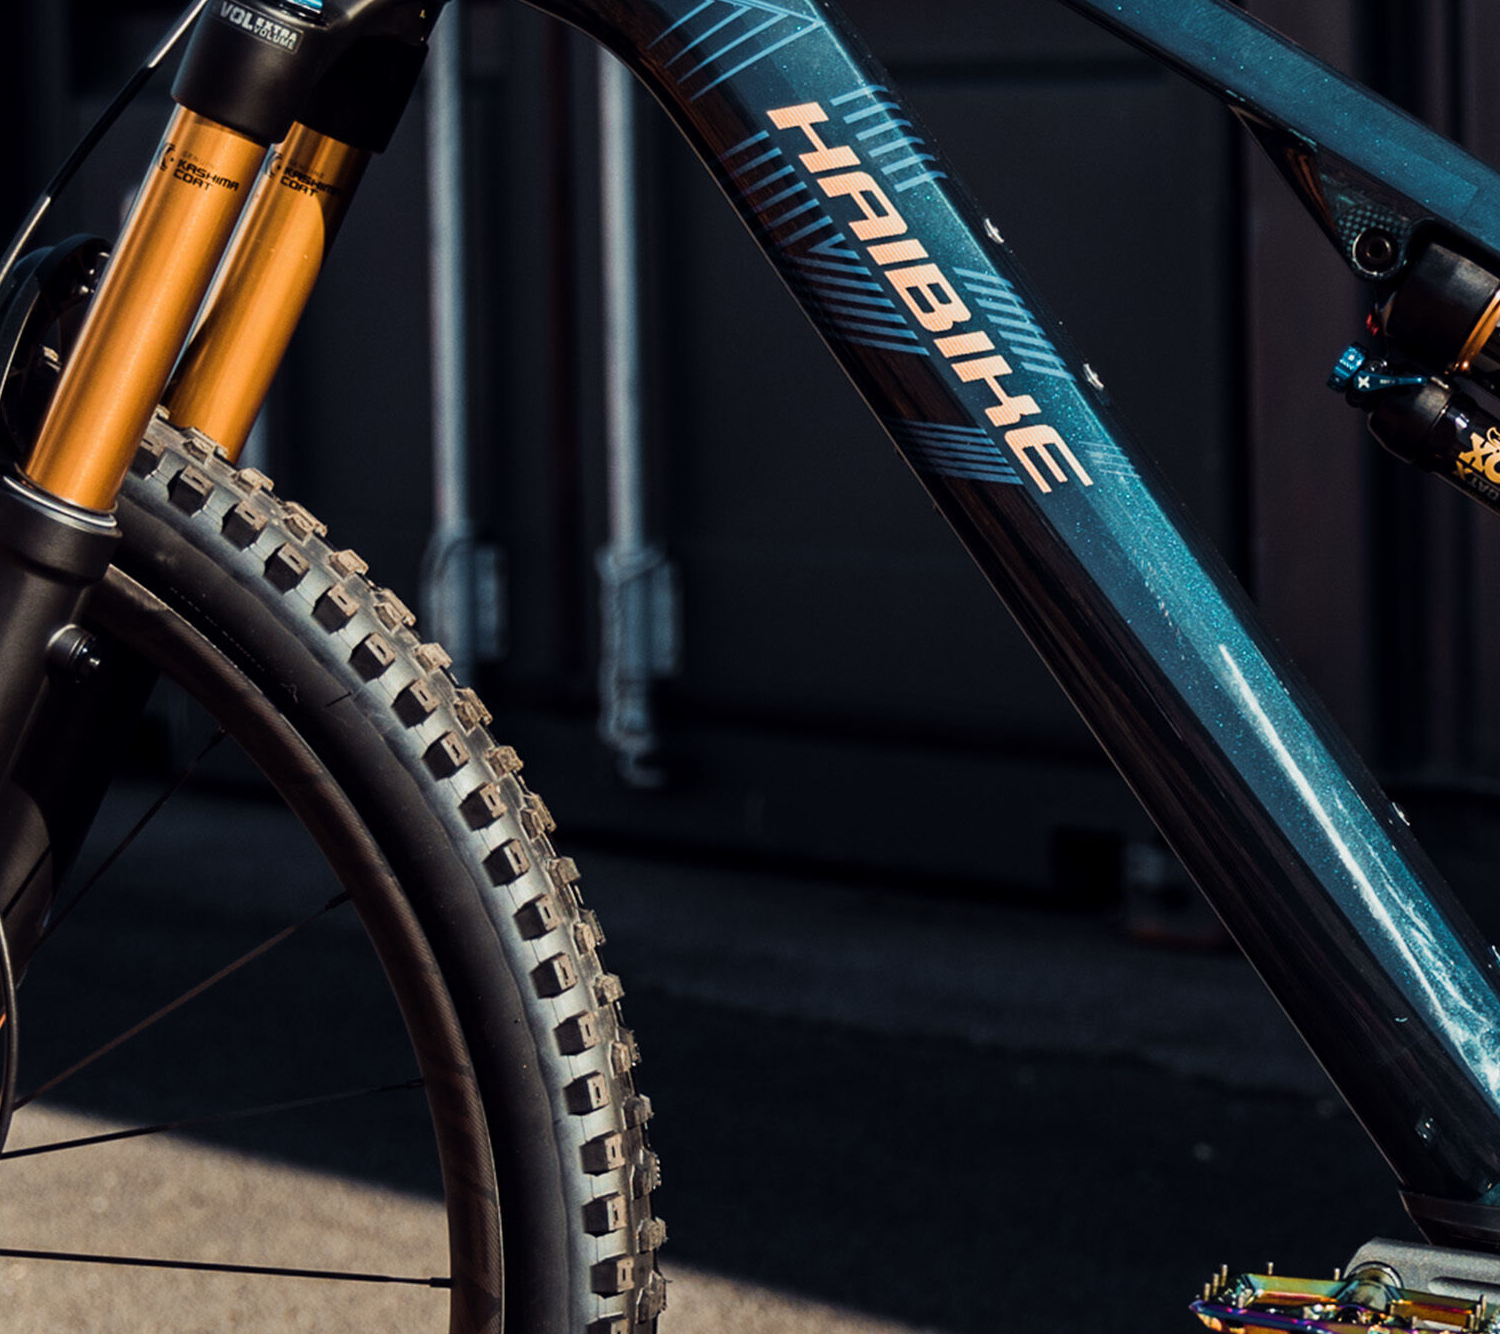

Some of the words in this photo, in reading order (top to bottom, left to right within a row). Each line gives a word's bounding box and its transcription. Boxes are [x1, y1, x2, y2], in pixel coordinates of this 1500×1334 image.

[173, 166, 214, 192] COAT
[177, 159, 240, 192] KASHIMA
[279, 175, 320, 198] COAT
[766, 101, 1094, 494] HAIBIKE
